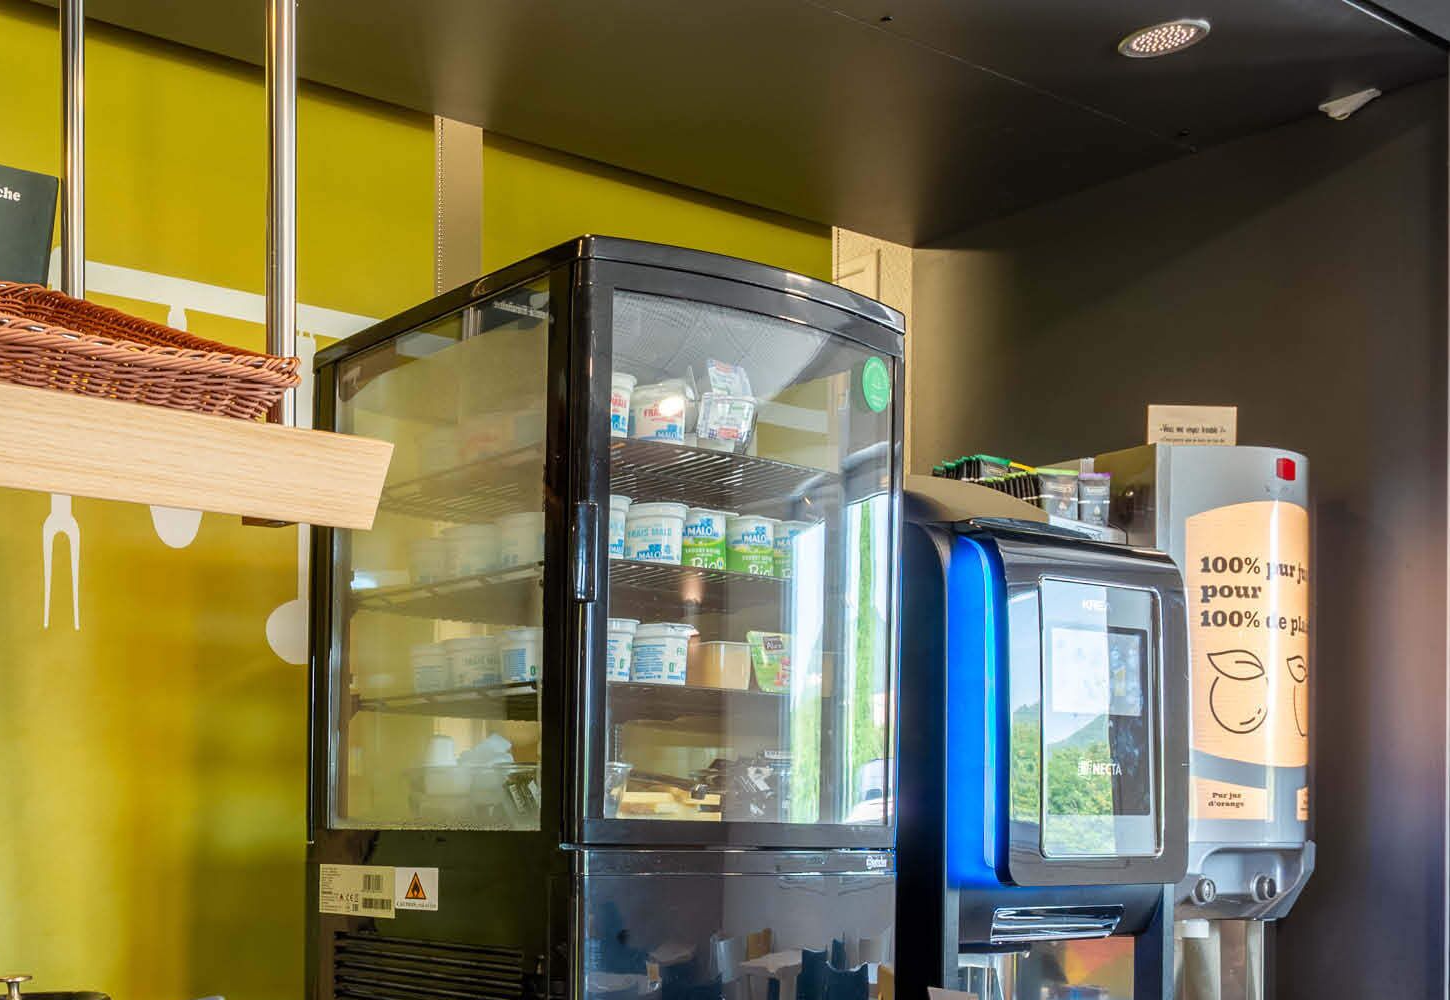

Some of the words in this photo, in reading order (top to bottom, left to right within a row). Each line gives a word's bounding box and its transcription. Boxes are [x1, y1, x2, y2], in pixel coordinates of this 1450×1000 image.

[686, 526, 713, 536] MALO
[743, 534, 766, 543] MALO
[1200, 555, 1261, 575] 100%
[1296, 562, 1308, 585] ju
[1200, 584, 1262, 604] pour
[1200, 609, 1261, 628] 100%
[1093, 762, 1123, 776] NECTA
[1228, 792, 1242, 801] jus
